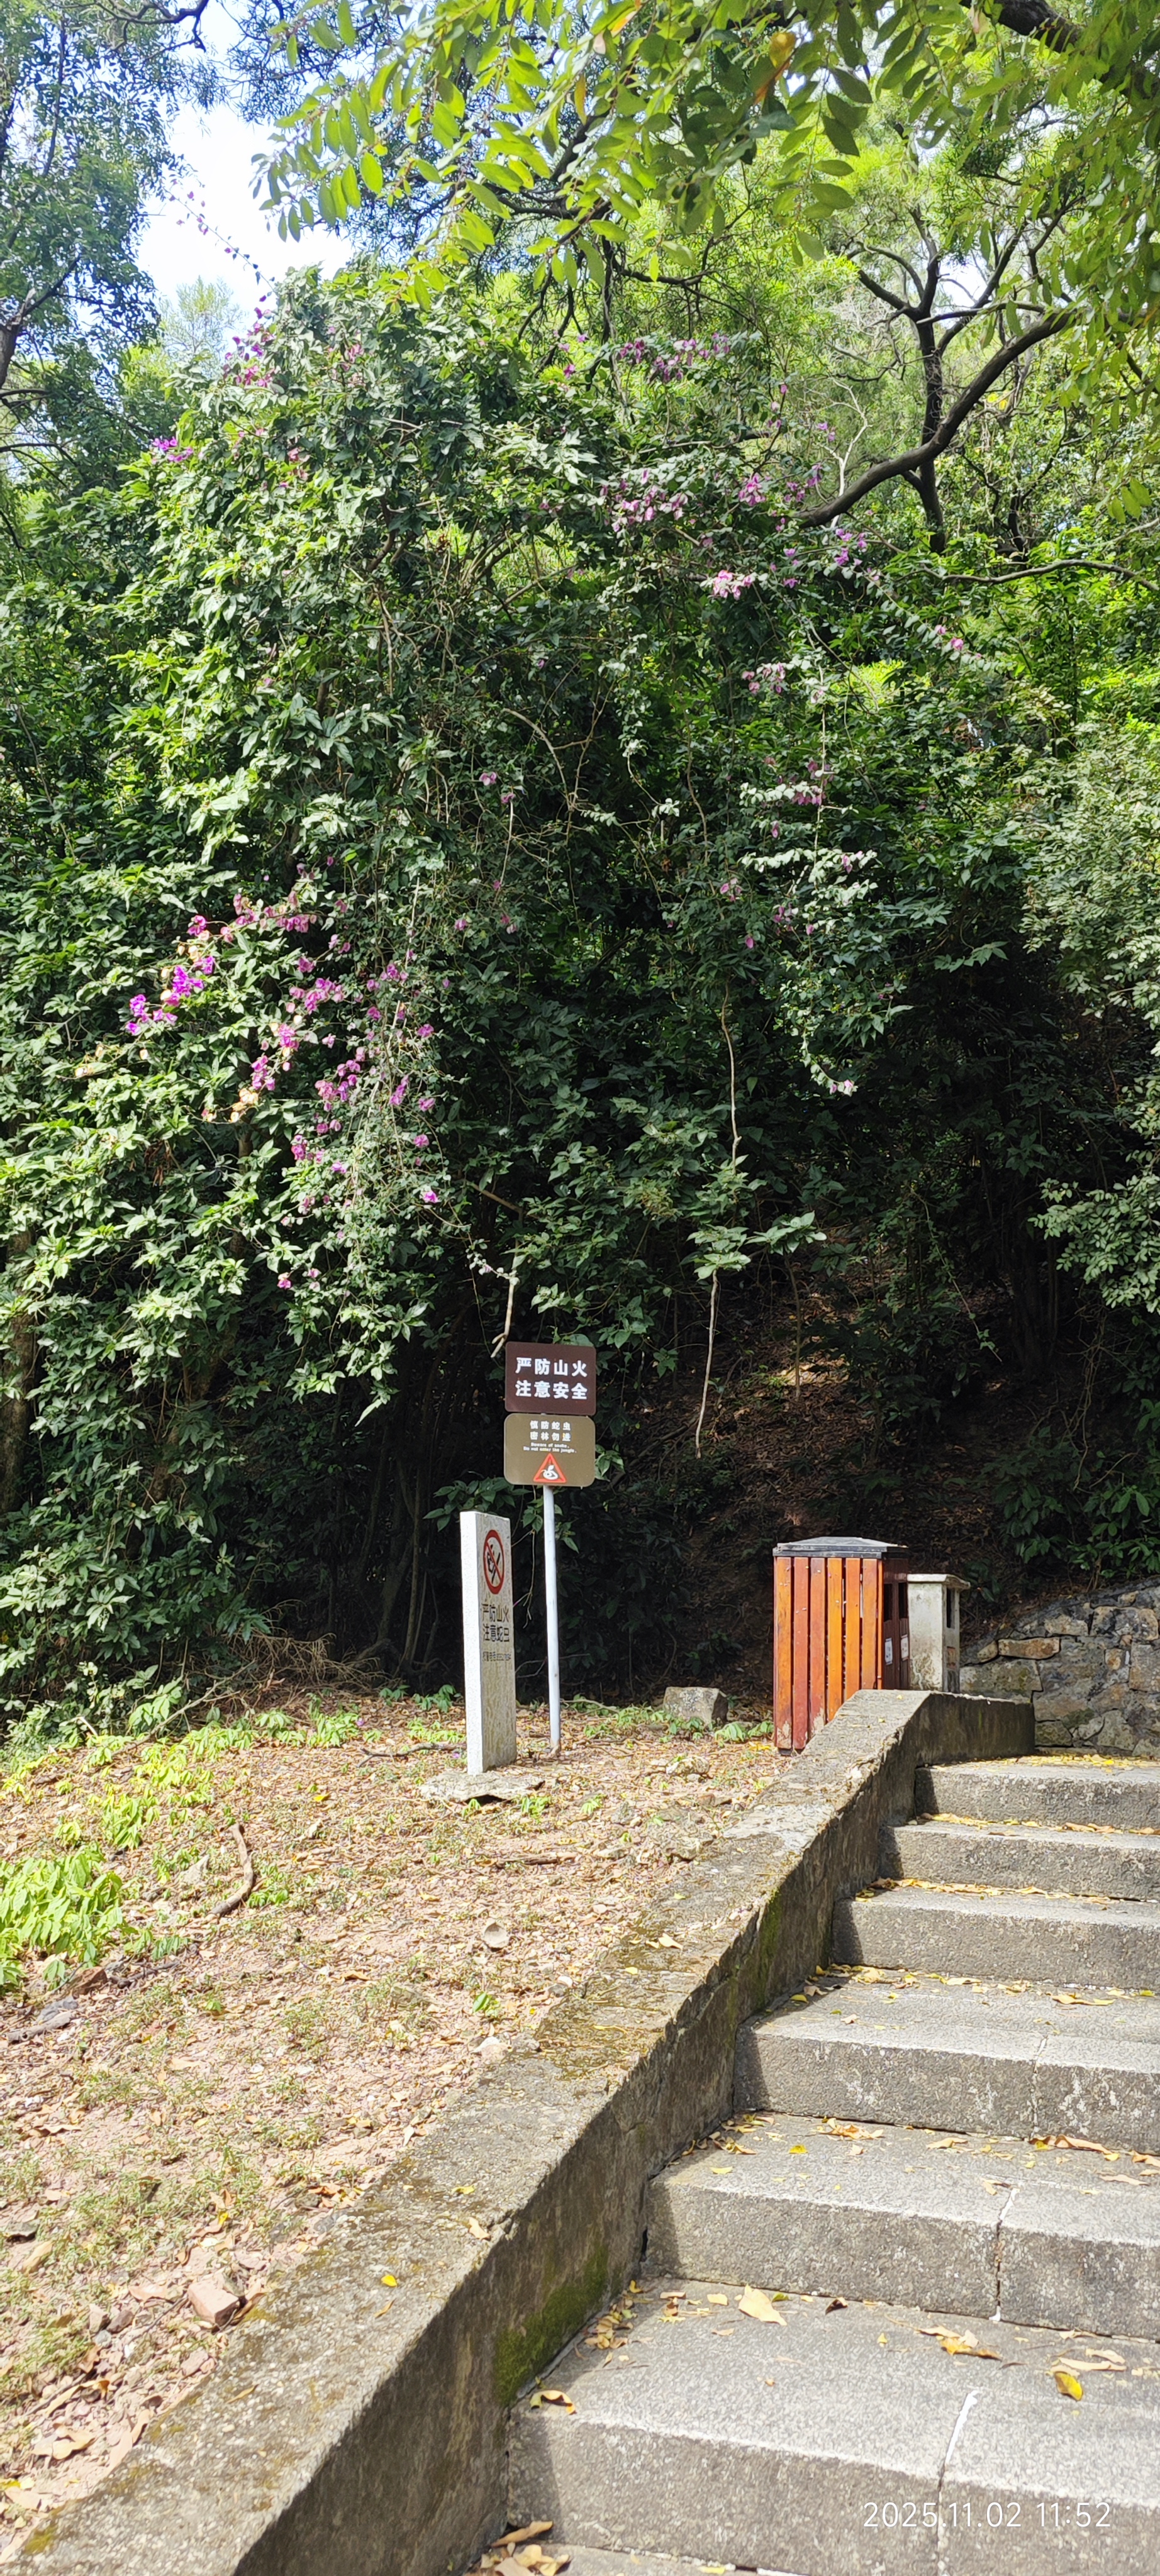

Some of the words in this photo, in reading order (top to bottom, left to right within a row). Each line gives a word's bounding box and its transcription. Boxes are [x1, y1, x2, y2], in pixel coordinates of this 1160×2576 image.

[515, 1357, 588, 1377] 严防山火
[515, 1380, 588, 1399] 注意安全
[530, 1420, 571, 1431] 慎防蛇虫
[530, 1431, 571, 1441] 密林勿进
[481, 1604, 510, 1622] 严防山火
